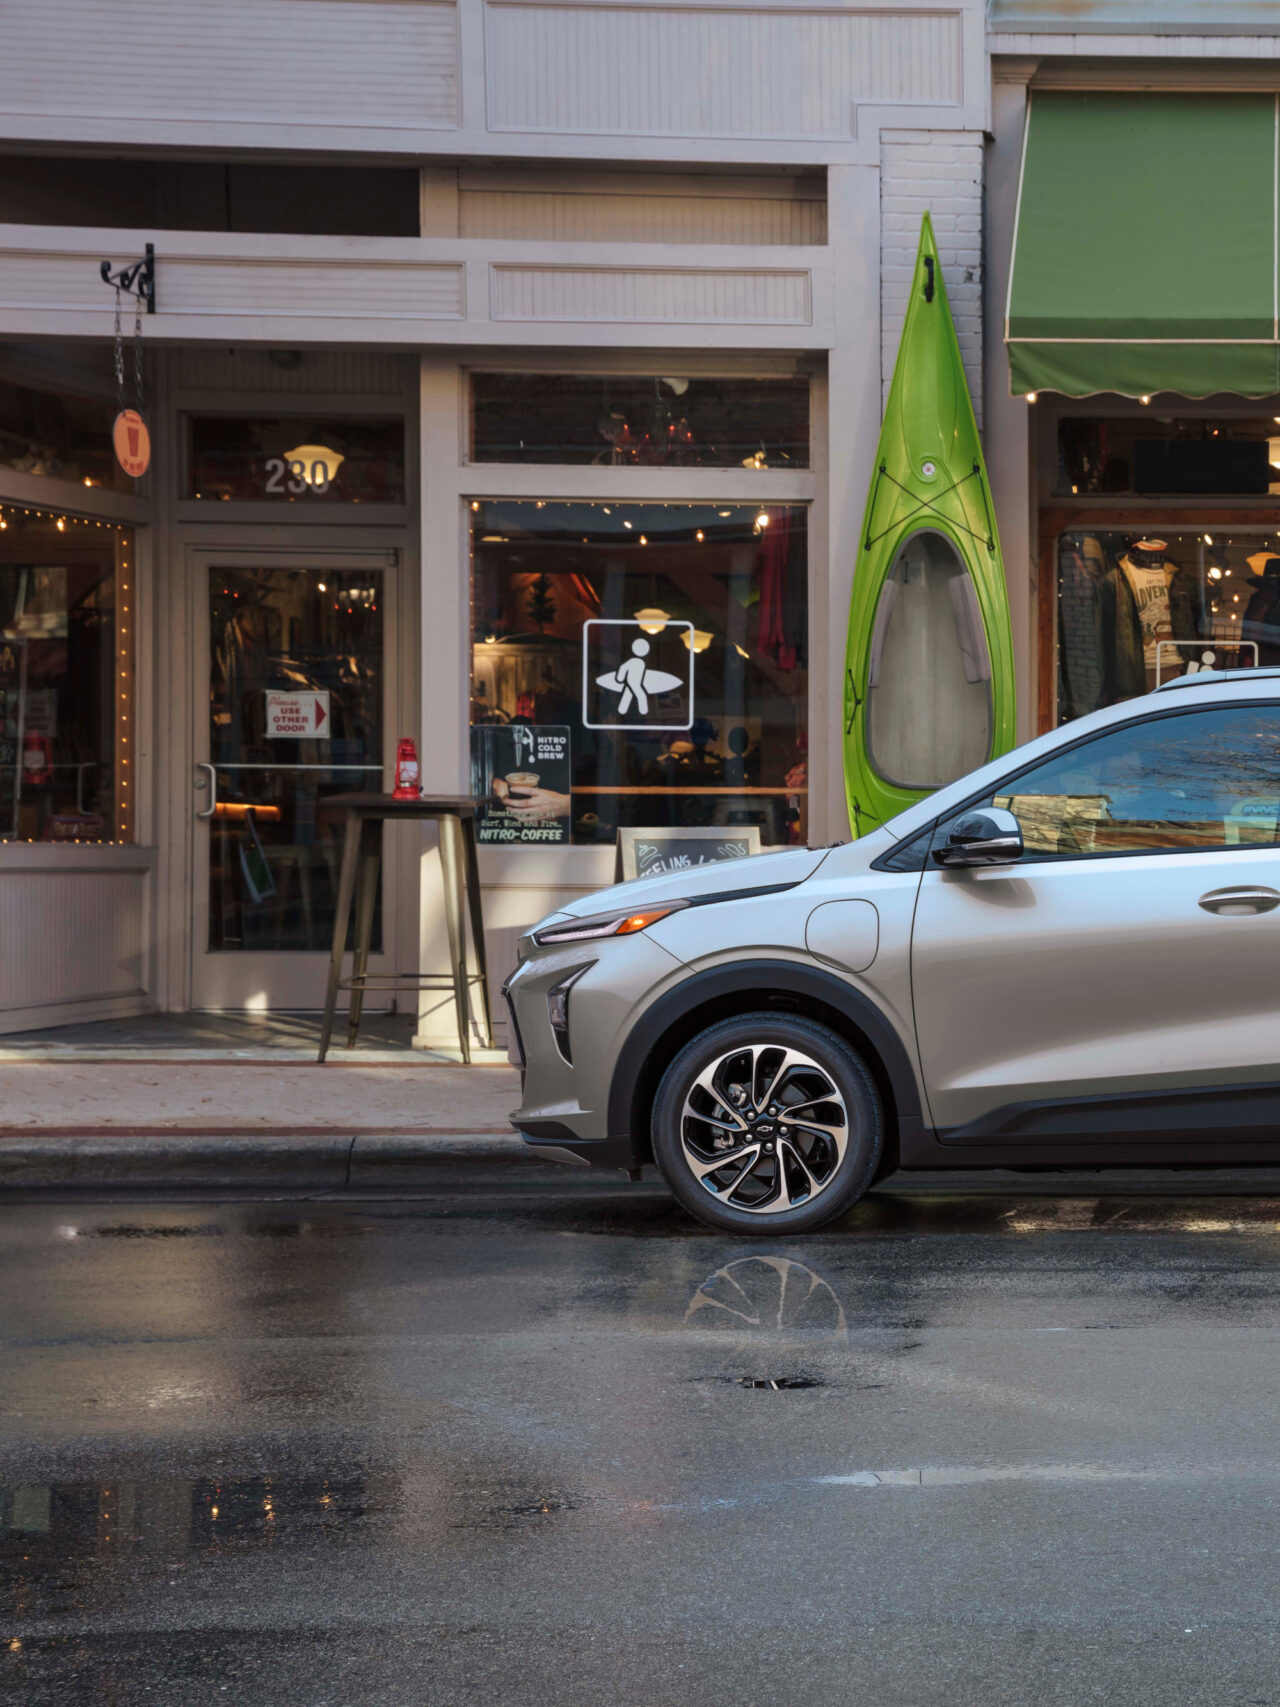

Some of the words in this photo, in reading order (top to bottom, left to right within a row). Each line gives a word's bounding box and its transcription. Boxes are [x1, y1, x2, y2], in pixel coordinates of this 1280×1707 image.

[265, 459, 329, 493] 230
[1135, 585, 1169, 612] DVEN
[280, 707, 301, 715] USE
[273, 716, 309, 724] OTHER
[537, 736, 567, 744] NITRO
[537, 744, 562, 752] COLD
[537, 752, 565, 760] BREW
